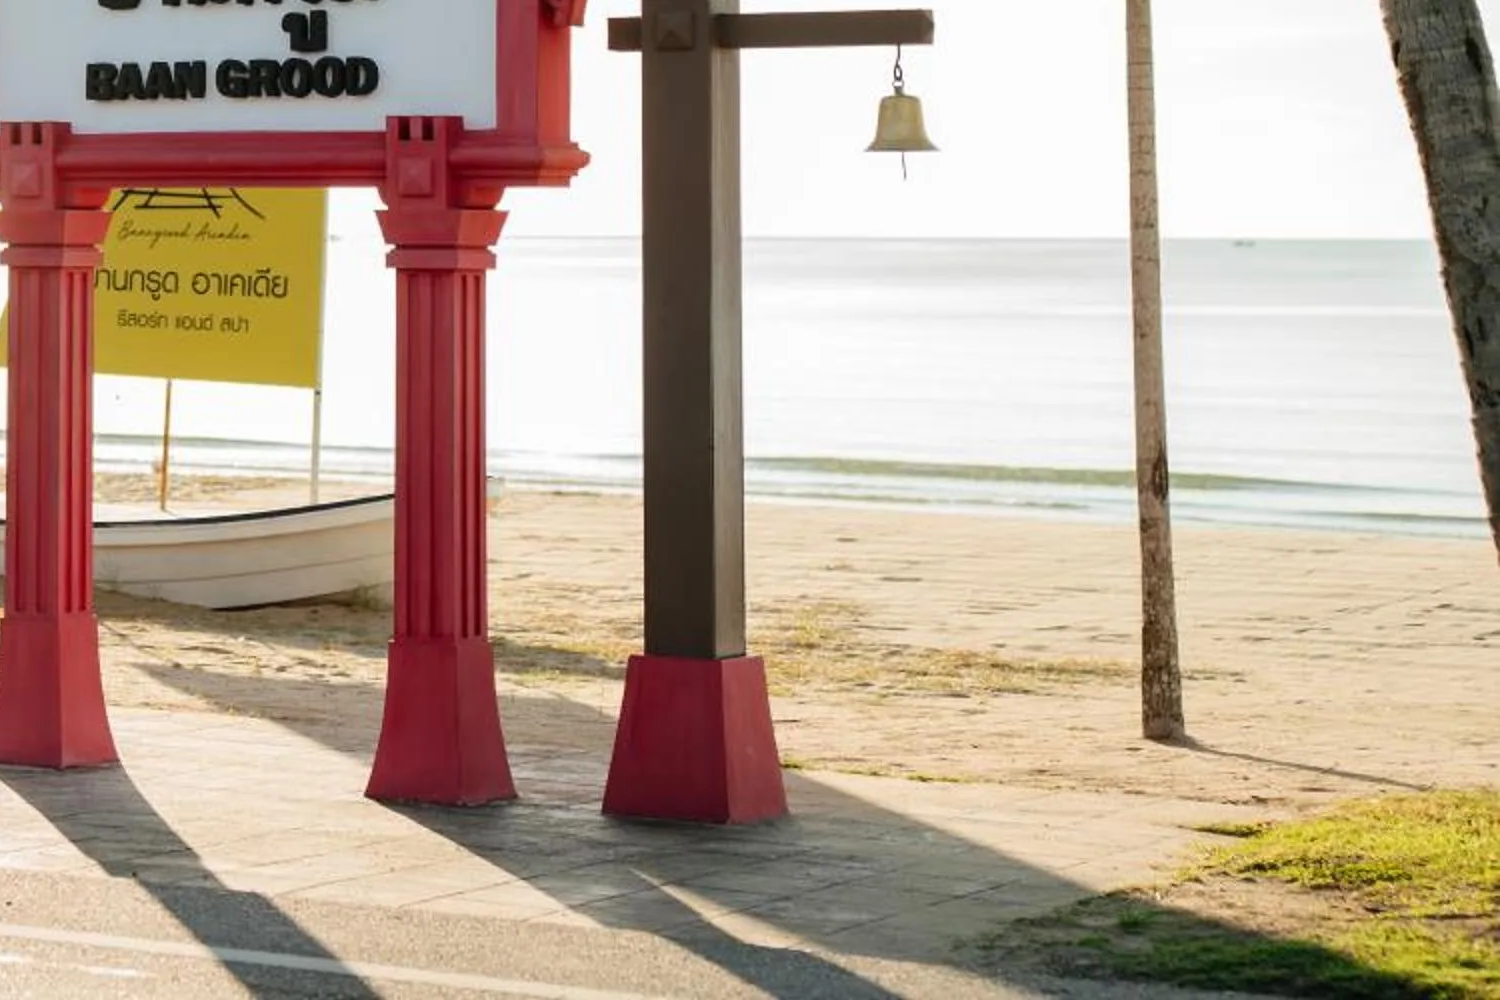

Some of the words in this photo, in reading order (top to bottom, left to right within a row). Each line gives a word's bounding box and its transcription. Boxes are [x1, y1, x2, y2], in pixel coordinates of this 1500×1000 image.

[86, 60, 206, 101] BAAN
[216, 56, 379, 98] GROOD
[93, 268, 179, 301] านกรูด
[192, 267, 288, 299] อาเคเดีย
[220, 315, 249, 333] สปา
